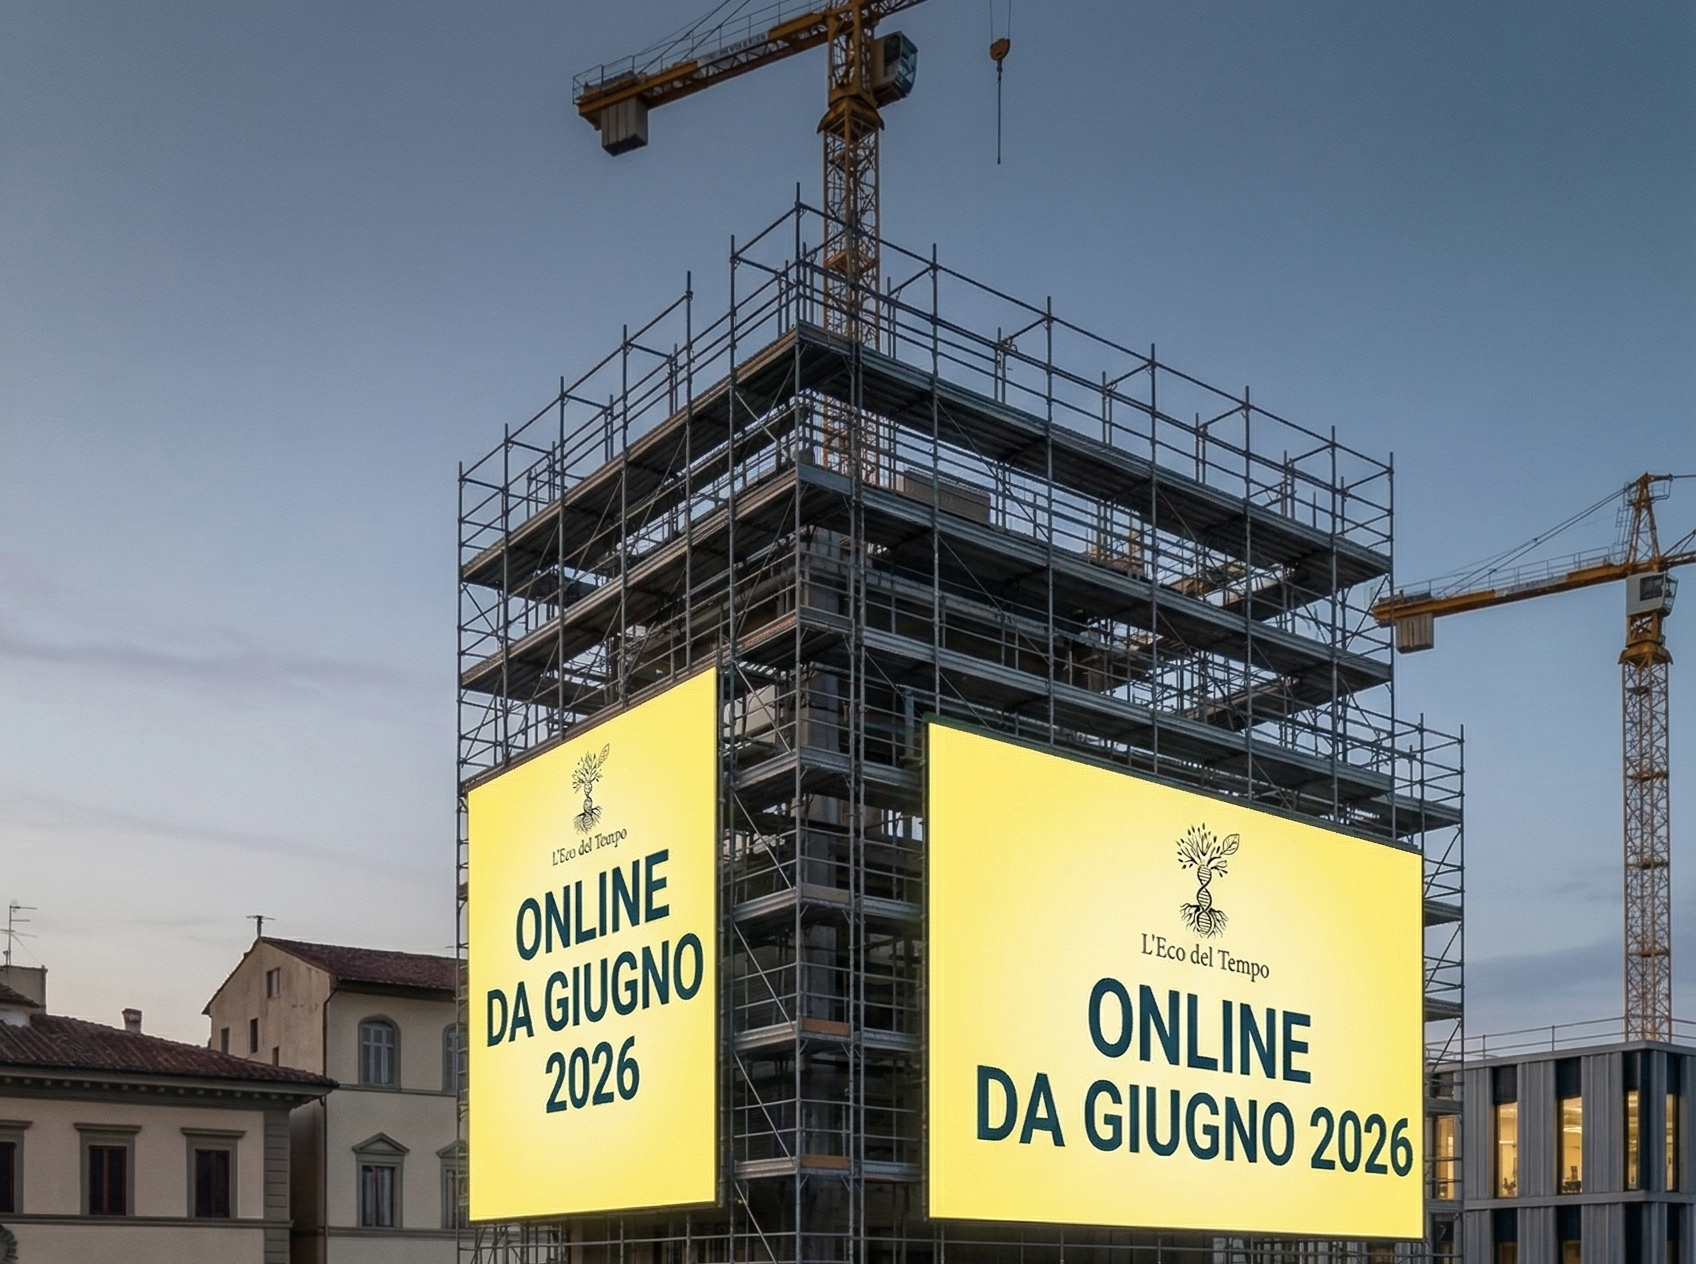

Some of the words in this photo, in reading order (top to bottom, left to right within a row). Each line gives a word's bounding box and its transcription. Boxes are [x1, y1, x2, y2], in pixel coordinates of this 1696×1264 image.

[516, 849, 670, 961] ONLINE
[1141, 933, 1186, 962] L'Eco
[1190, 943, 1214, 967] del
[1217, 949, 1270, 982] Tempo
[487, 980, 535, 1048] DA
[545, 932, 704, 1032] GIUGNO
[1089, 977, 1312, 1085] ONLINE
[545, 1035, 640, 1114] 2026
[976, 1065, 1066, 1148] DA
[1084, 1079, 1295, 1167] GIUGNO
[1310, 1106, 1414, 1177] 2026
